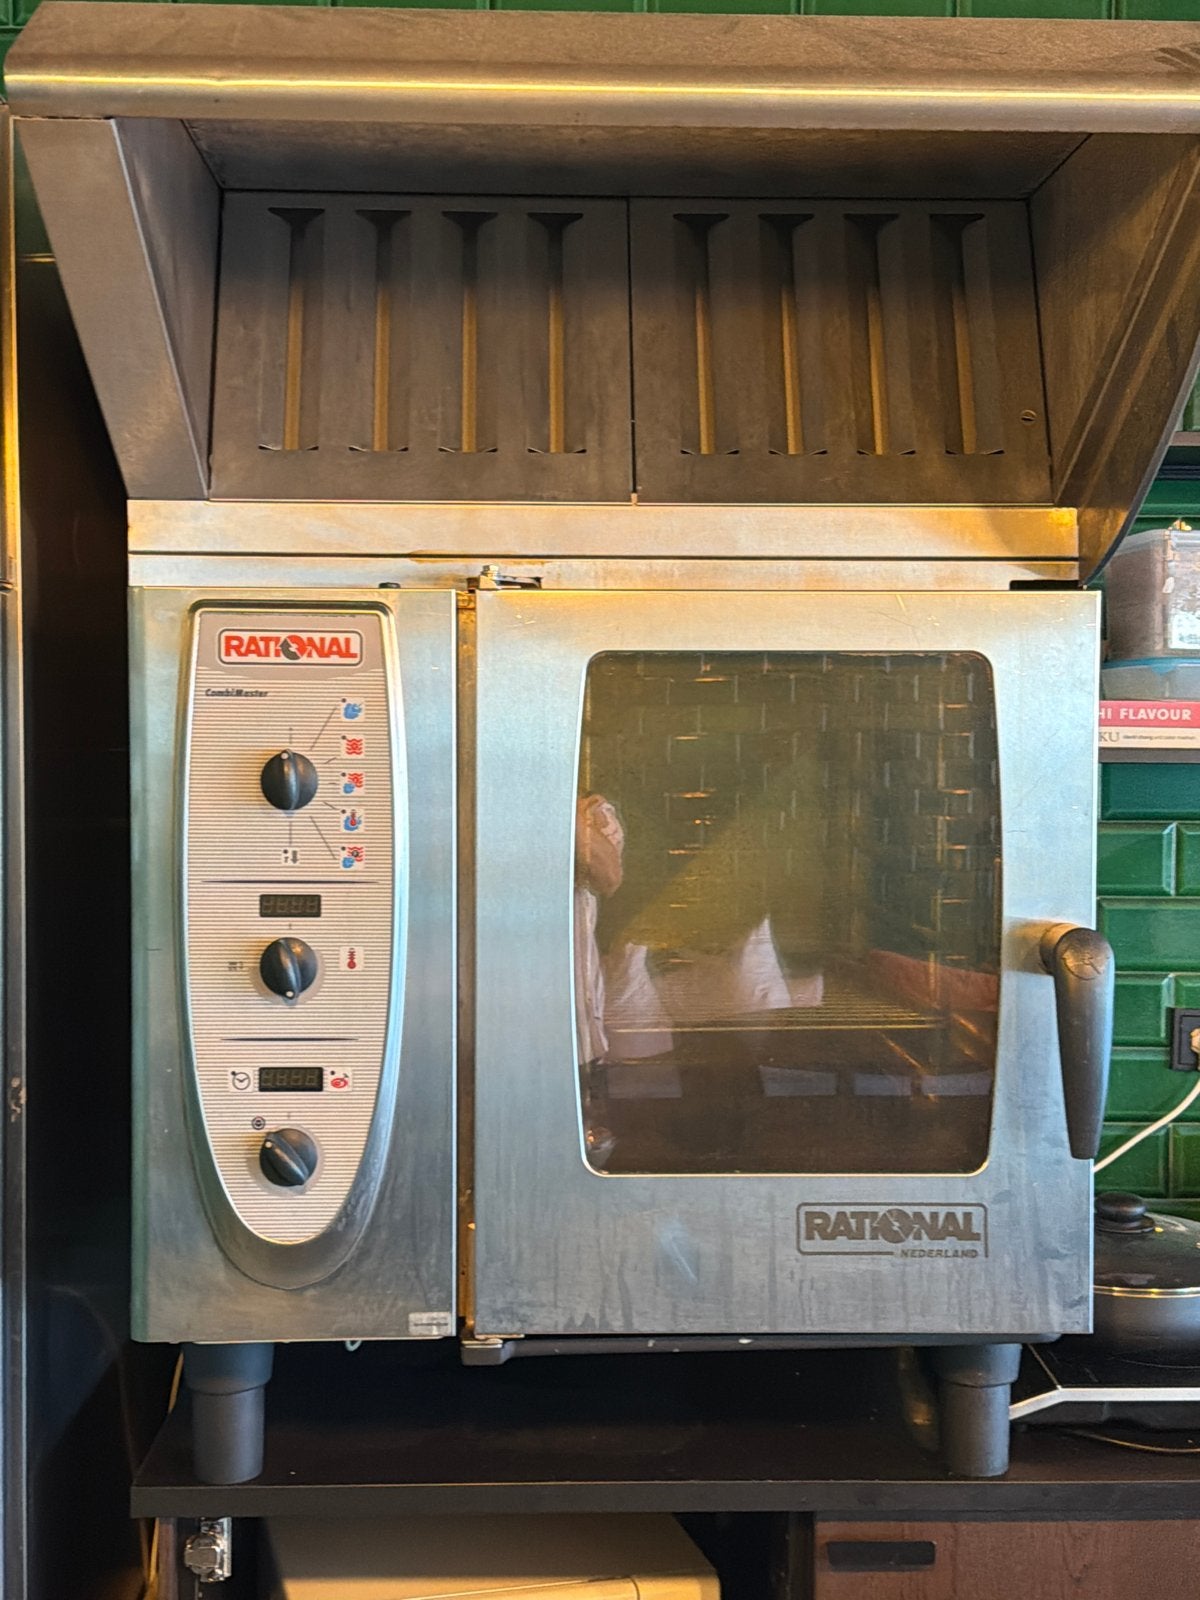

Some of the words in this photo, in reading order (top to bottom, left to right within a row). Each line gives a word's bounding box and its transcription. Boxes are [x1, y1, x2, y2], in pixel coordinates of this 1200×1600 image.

[224, 635, 357, 660] RATIONAL
[205, 688, 268, 698] CombiMaster
[1119, 708, 1192, 720] FLAVOUR
[805, 1209, 981, 1243] RATIONAL
[901, 1249, 978, 1258] NEDERLAND
